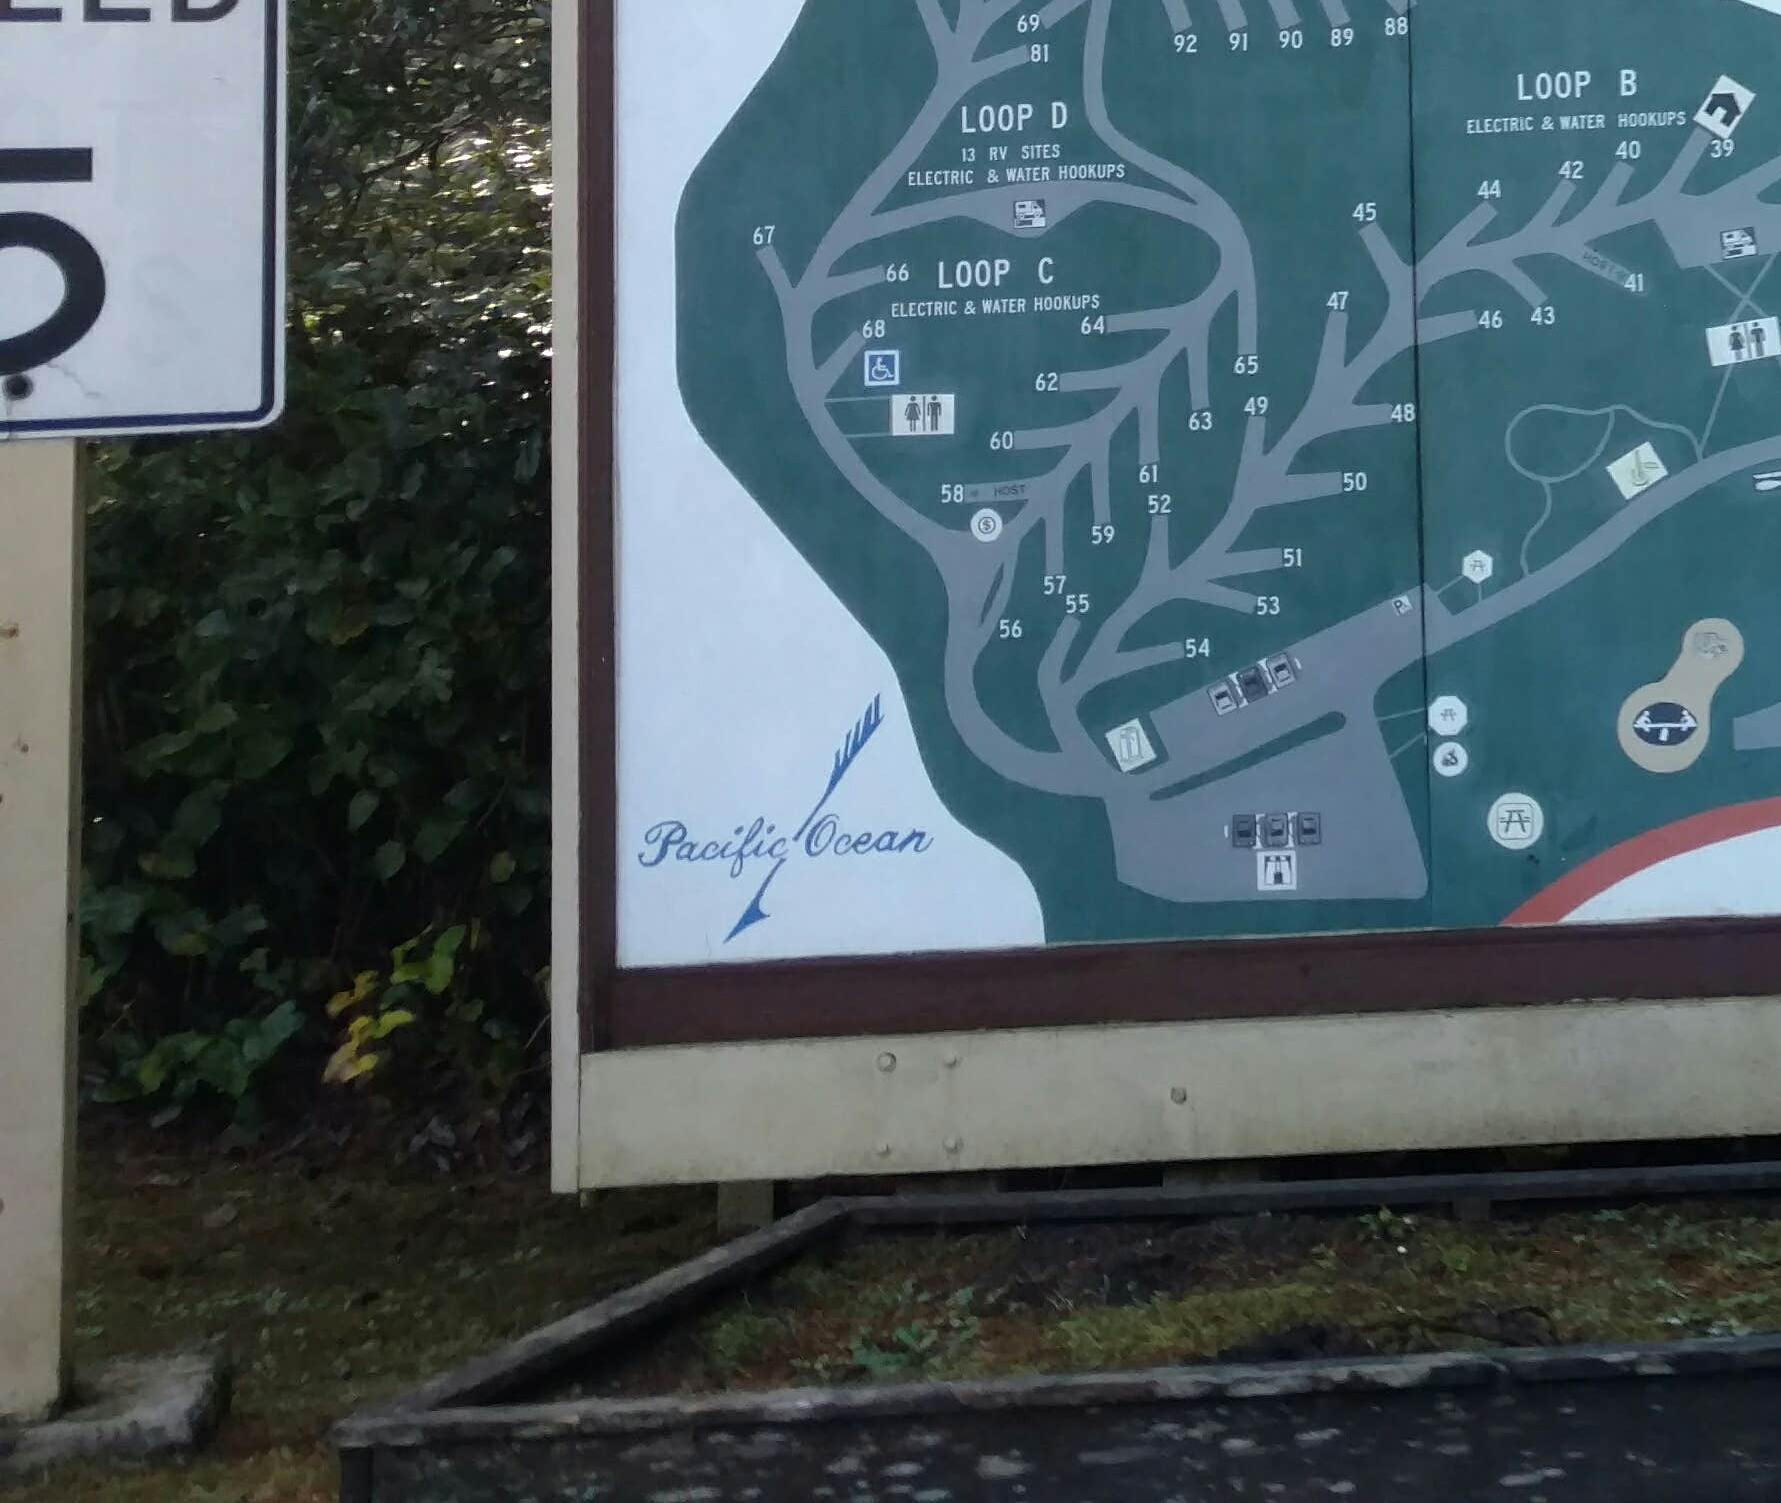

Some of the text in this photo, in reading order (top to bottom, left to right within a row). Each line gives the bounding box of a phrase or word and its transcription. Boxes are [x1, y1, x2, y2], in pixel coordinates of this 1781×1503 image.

[1017, 13, 1040, 33] 69
[1384, 16, 1408, 36] 88
[1174, 34, 1197, 53] 92
[1229, 32, 1248, 51] 91
[1279, 30, 1303, 49] 90
[1330, 27, 1354, 47] 89
[1030, 43, 1049, 63] 81
[1517, 69, 1637, 101] LOOP B
[961, 101, 1068, 133] LOOP D
[1466, 111, 1686, 134] ELECTRIC & WATER HOOKUPS
[962, 144, 1060, 162] 13 RV SITES
[1615, 140, 1641, 160] 40
[1710, 137, 1735, 158] 39
[908, 163, 1125, 186] ELECTRIC & WATER HOOKUPS
[1558, 160, 1584, 179] 42
[1477, 179, 1502, 199] 44
[1352, 202, 1377, 222] 45
[753, 224, 776, 245] 67
[886, 263, 909, 282] 66
[938, 256, 1054, 289] LOOP C
[1623, 273, 1644, 293] 41
[891, 294, 1100, 318] ELECTRIC & WATER HOOKUPS
[1326, 290, 1349, 310] 47
[1081, 315, 1105, 335] 64
[1478, 310, 1503, 329] 46
[1530, 306, 1555, 325] 43
[862, 319, 886, 339] 68
[1234, 355, 1259, 375] 65
[1035, 372, 1059, 392] 62
[1243, 396, 1268, 416] 49
[1390, 403, 1416, 423] 48
[1188, 411, 1212, 431] 63
[990, 430, 1014, 450] 60
[1139, 464, 1158, 484] 61
[1343, 472, 1368, 492] 50
[941, 484, 964, 504] 58
[1148, 494, 1171, 514] 52
[1091, 525, 1115, 545] 59
[1283, 548, 1302, 567] 51
[1043, 575, 1067, 595] 57
[1065, 593, 1090, 614] 55
[1257, 596, 1280, 615] 53
[999, 619, 1022, 638] 56
[1185, 638, 1210, 658] 54
[637, 815, 933, 879] Pacific Ocean
